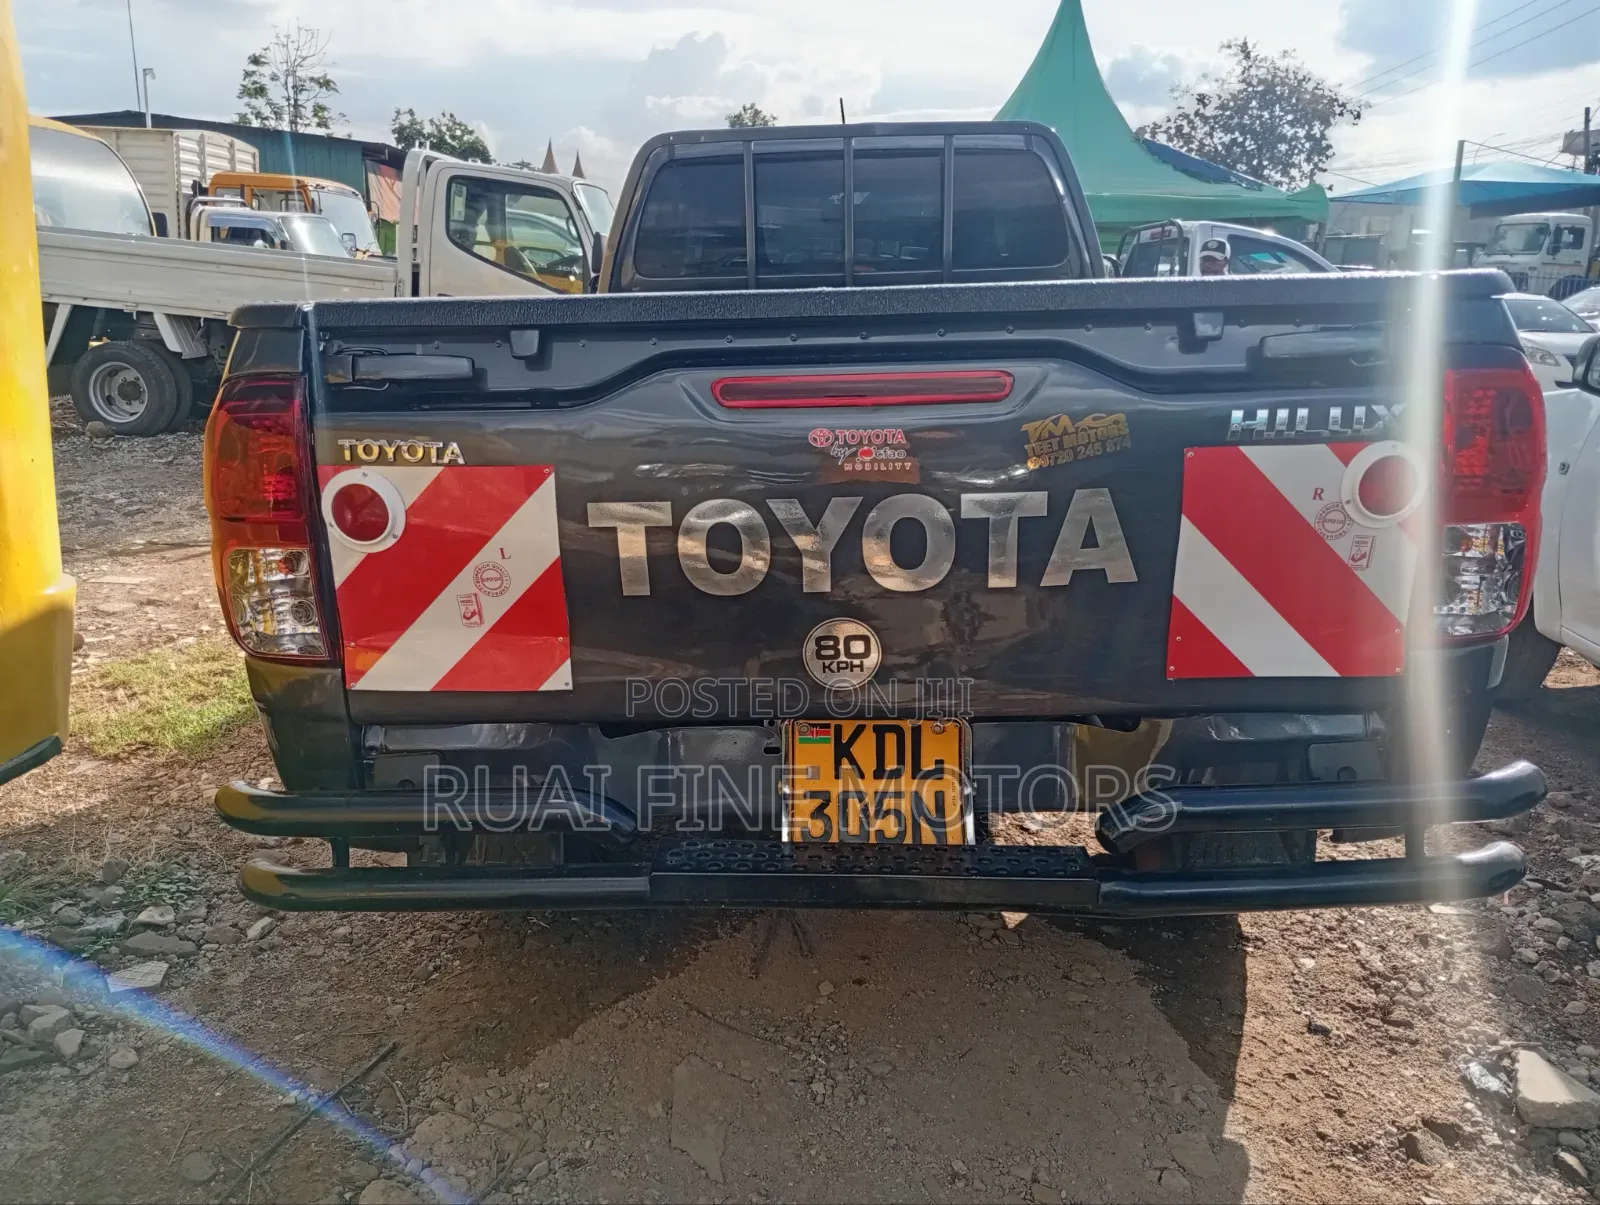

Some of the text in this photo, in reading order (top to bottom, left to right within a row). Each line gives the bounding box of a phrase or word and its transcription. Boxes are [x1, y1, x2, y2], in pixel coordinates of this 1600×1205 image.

[1227, 404, 1406, 440] HILUX
[836, 429, 906, 445] TOYOTA
[338, 439, 465, 465] TOYOTA
[831, 441, 907, 465] by cfao
[844, 462, 912, 471] MOBILITY
[1312, 487, 1324, 501] R
[499, 547, 511, 560] L
[587, 488, 1138, 596] TOYOTA
[815, 635, 871, 660] 80
[822, 660, 864, 673] KPH
[833, 724, 945, 780] KDL
[801, 790, 947, 844] 305N
